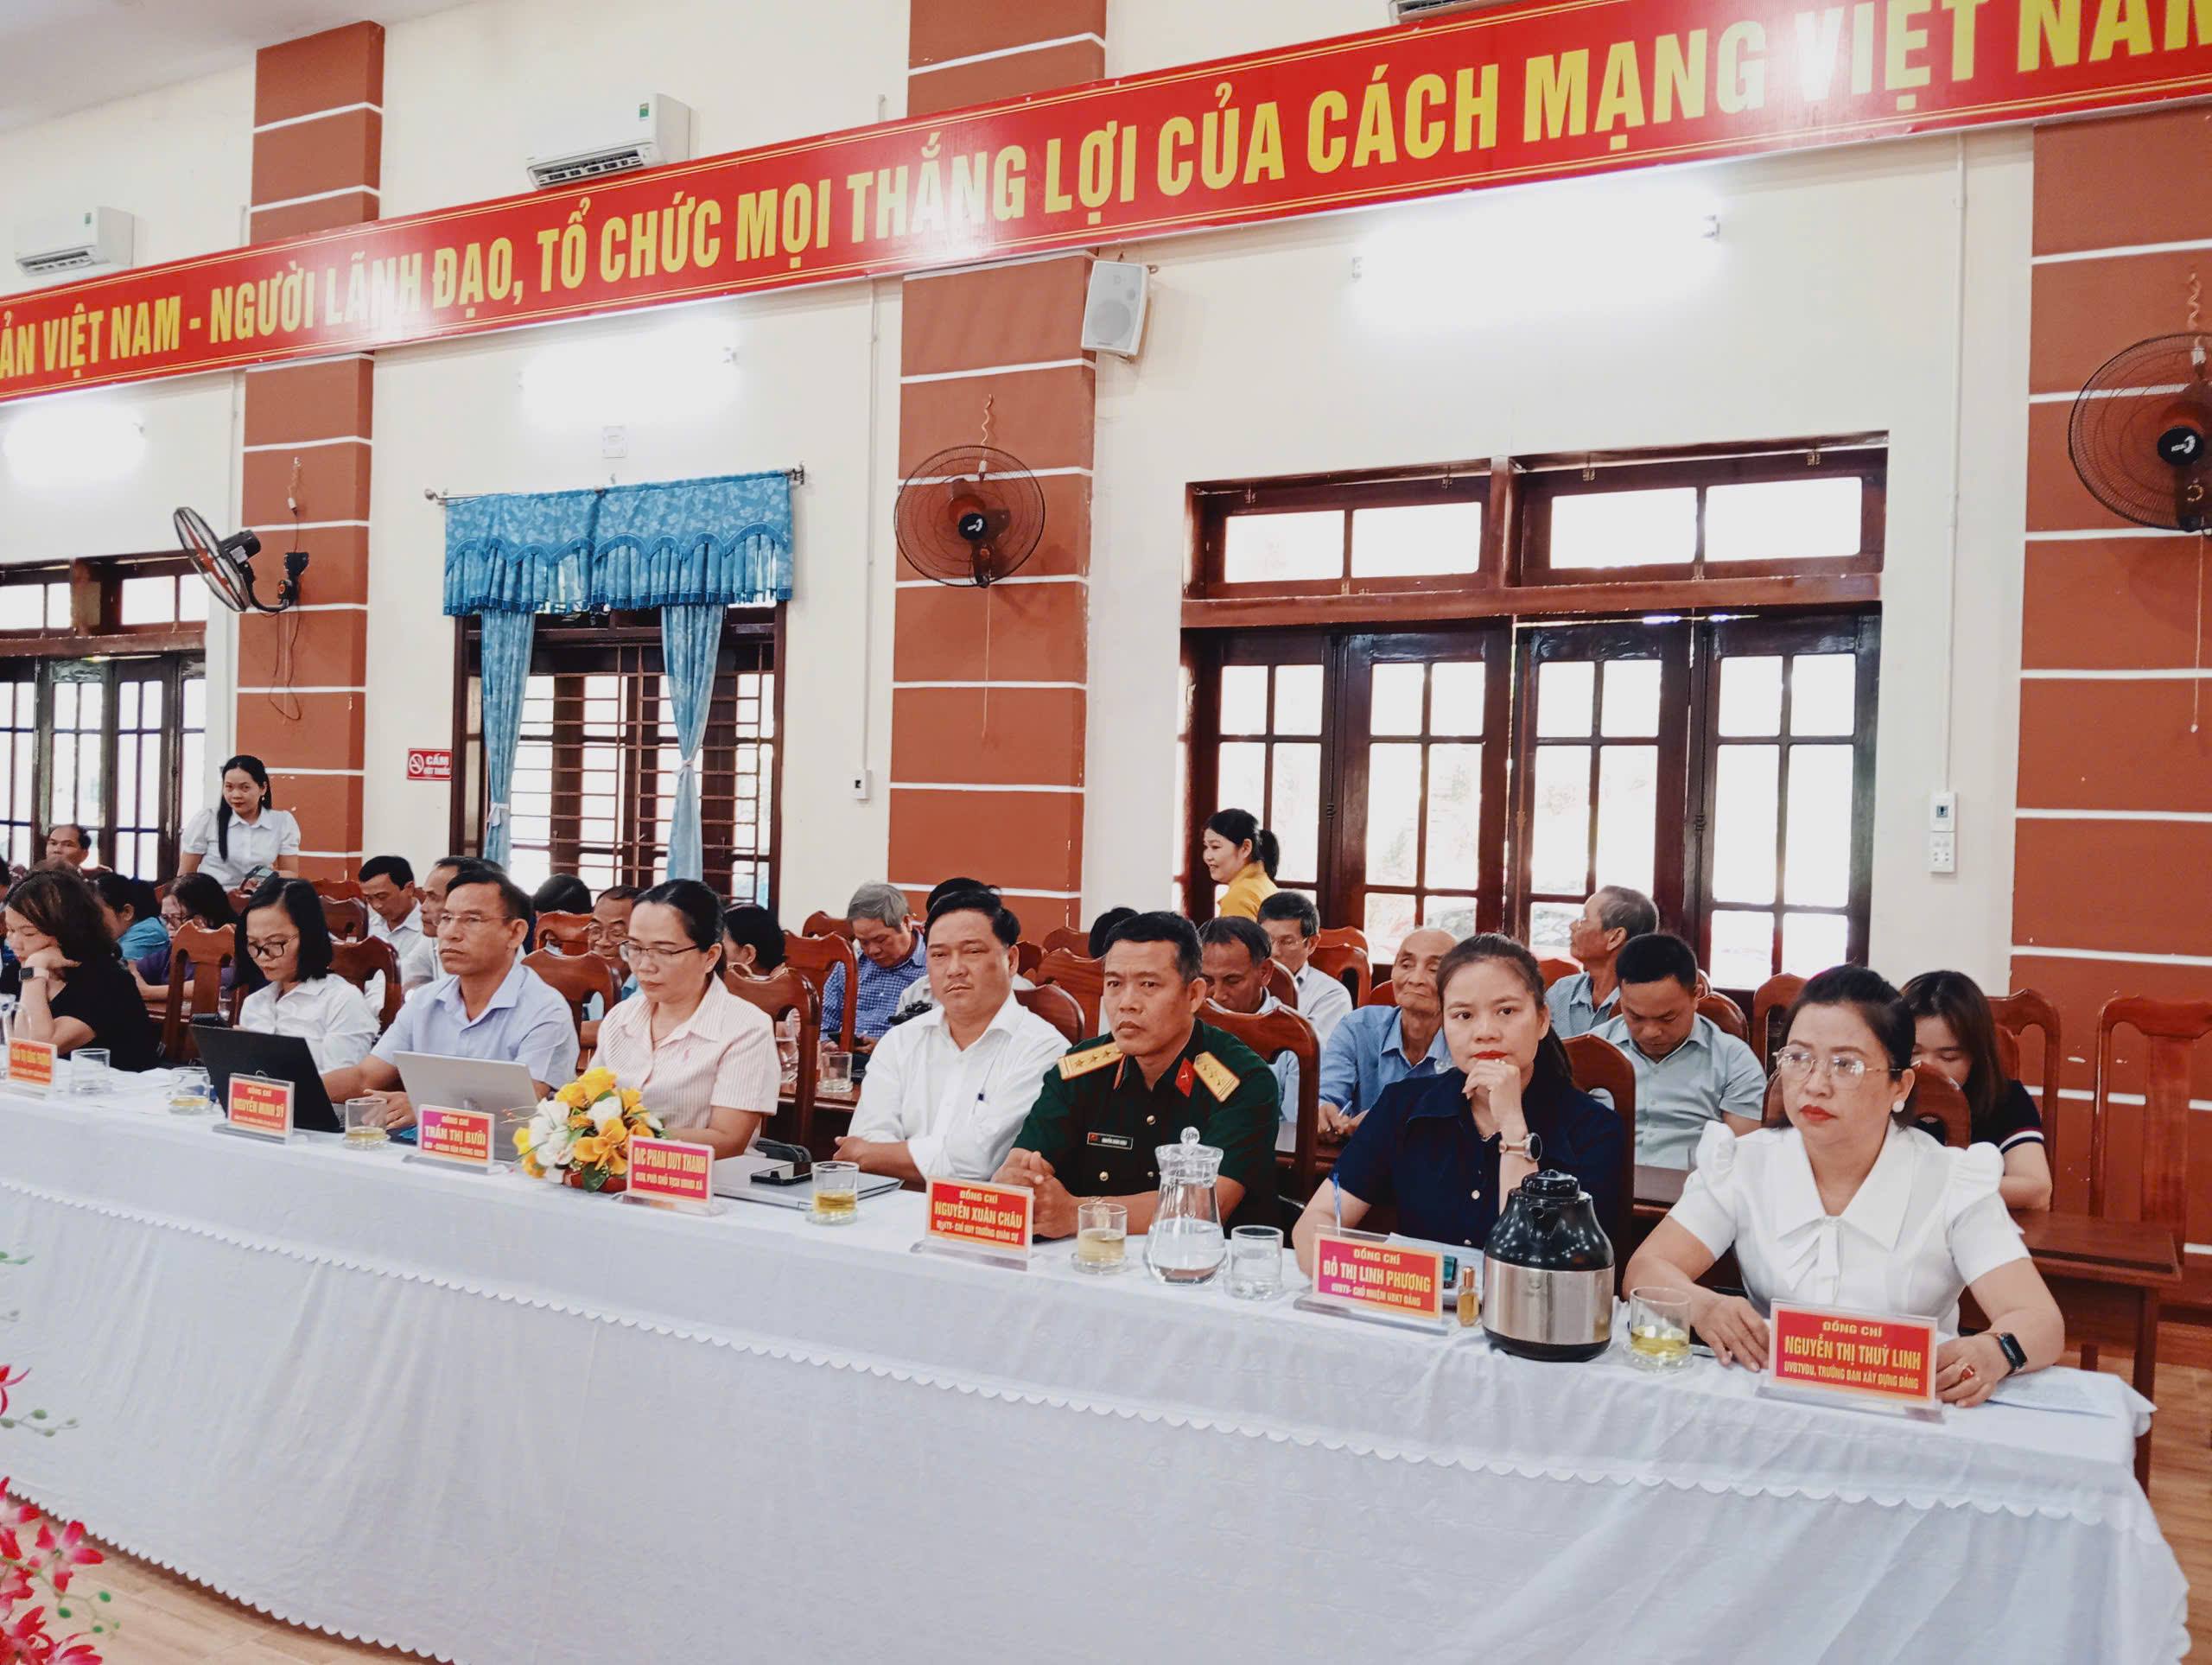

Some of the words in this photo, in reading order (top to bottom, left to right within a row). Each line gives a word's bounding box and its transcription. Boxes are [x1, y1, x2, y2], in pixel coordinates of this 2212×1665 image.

[42, 302, 104, 378] VIỆT
[110, 296, 181, 359] NAM
[210, 261, 315, 343] NGƯỜI
[325, 251, 423, 327] LÃNH
[432, 238, 523, 318] ĐẠO,
[537, 197, 591, 292] TỔ
[600, 191, 721, 283] CHỨC
[736, 179, 831, 269] MỌI
[846, 131, 1027, 243] THẮNG
[1045, 120, 1137, 225] LỢI
[1158, 82, 1286, 196] CỦA
[1307, 63, 1499, 173] CÁCH
[1523, 21, 1765, 150] MẠNG
[448, 1128, 464, 1145] THỊ
[647, 1148, 667, 1168] PHAN
[667, 1151, 682, 1170] DUY
[983, 1192, 998, 1204] CHÍ
[935, 1200, 970, 1219] NGUYỄN
[971, 1207, 996, 1224] XUÂN
[998, 1211, 1023, 1229] CHÂU
[1354, 1247, 1381, 1261] ĐỒNG
[1383, 1253, 1401, 1265] CHÍ
[1340, 1262, 1357, 1284] THỊ
[1359, 1265, 1384, 1285] LINH
[1386, 1270, 1431, 1293] PHƯƠNG
[1822, 1320, 1857, 1335] ĐỒNG
[1860, 1325, 1882, 1338] CHÍ
[1784, 1333, 1834, 1359] NGUYỄN
[1836, 1342, 1855, 1366] THỊ
[1891, 1349, 1921, 1370] LINH
[1847, 1369, 1862, 1382] BAN
